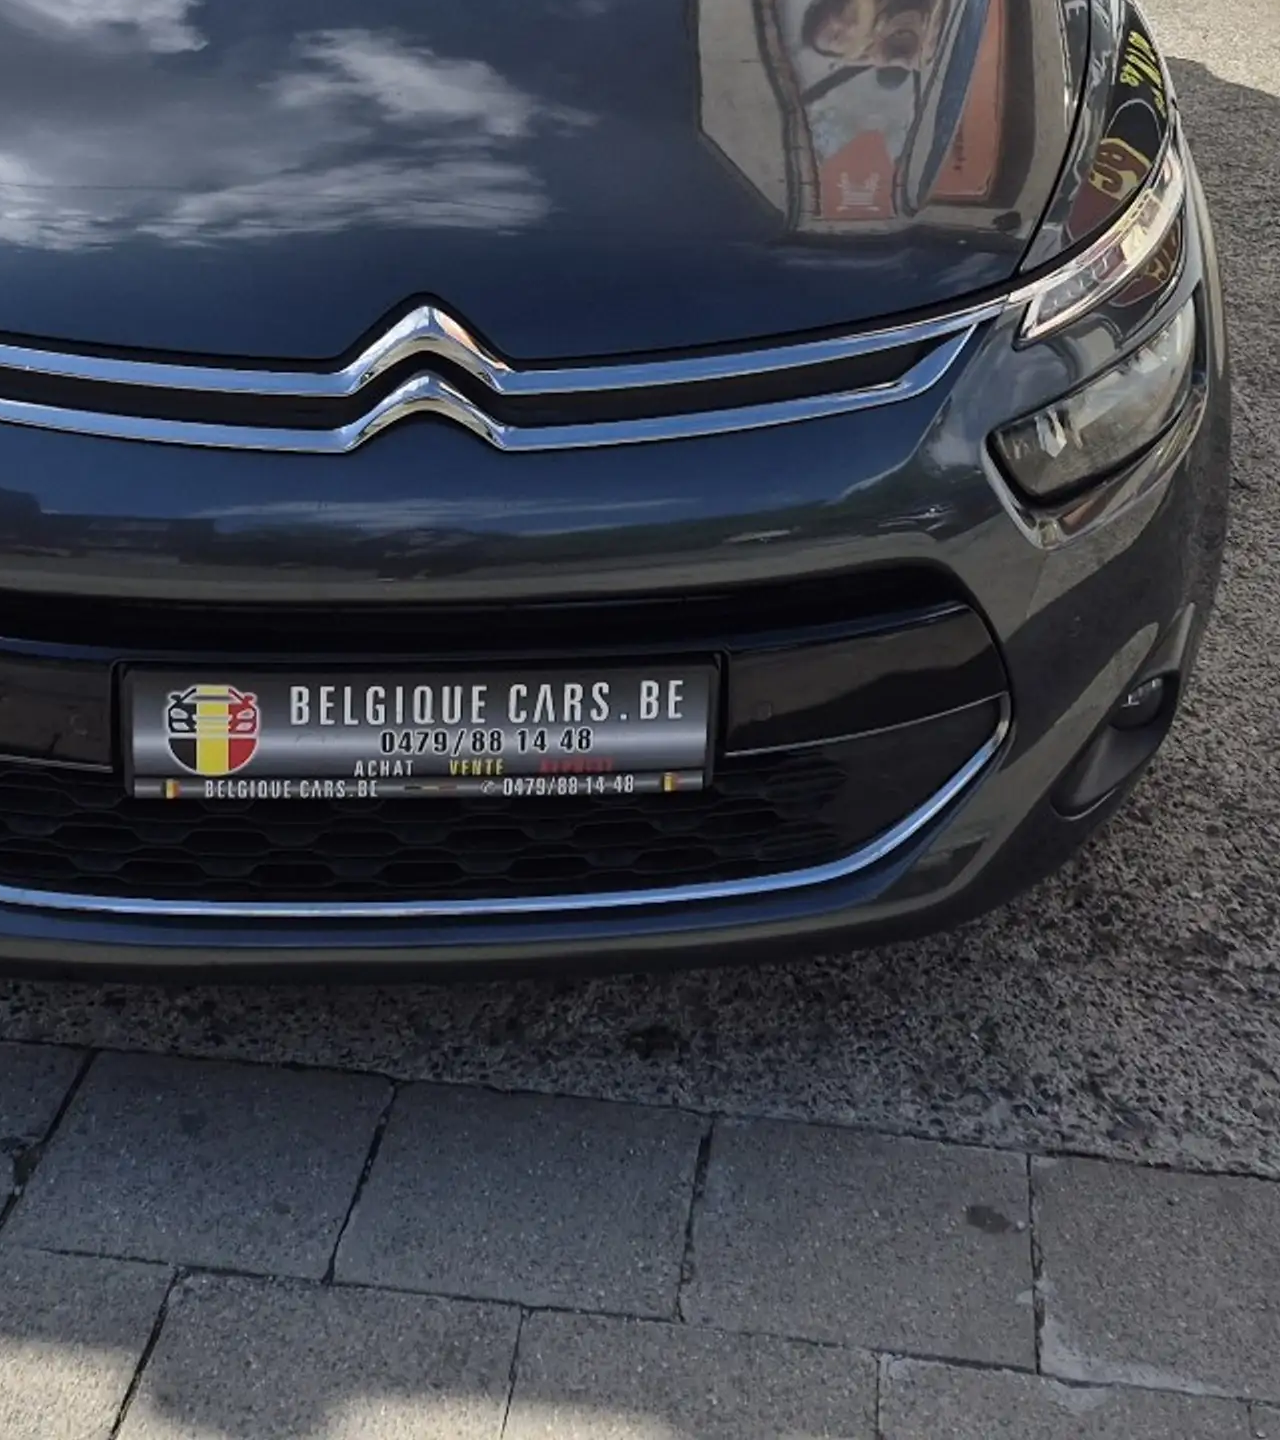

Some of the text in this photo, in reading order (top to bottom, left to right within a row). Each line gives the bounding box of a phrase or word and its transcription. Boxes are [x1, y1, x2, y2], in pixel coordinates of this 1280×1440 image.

[290, 684, 488, 726] BELGIQUE
[379, 726, 594, 756] 0479/88 14 48
[354, 759, 504, 777] ACHAT VENTE
[204, 780, 292, 799] BELGIQUE
[502, 775, 578, 796] 0479/88
